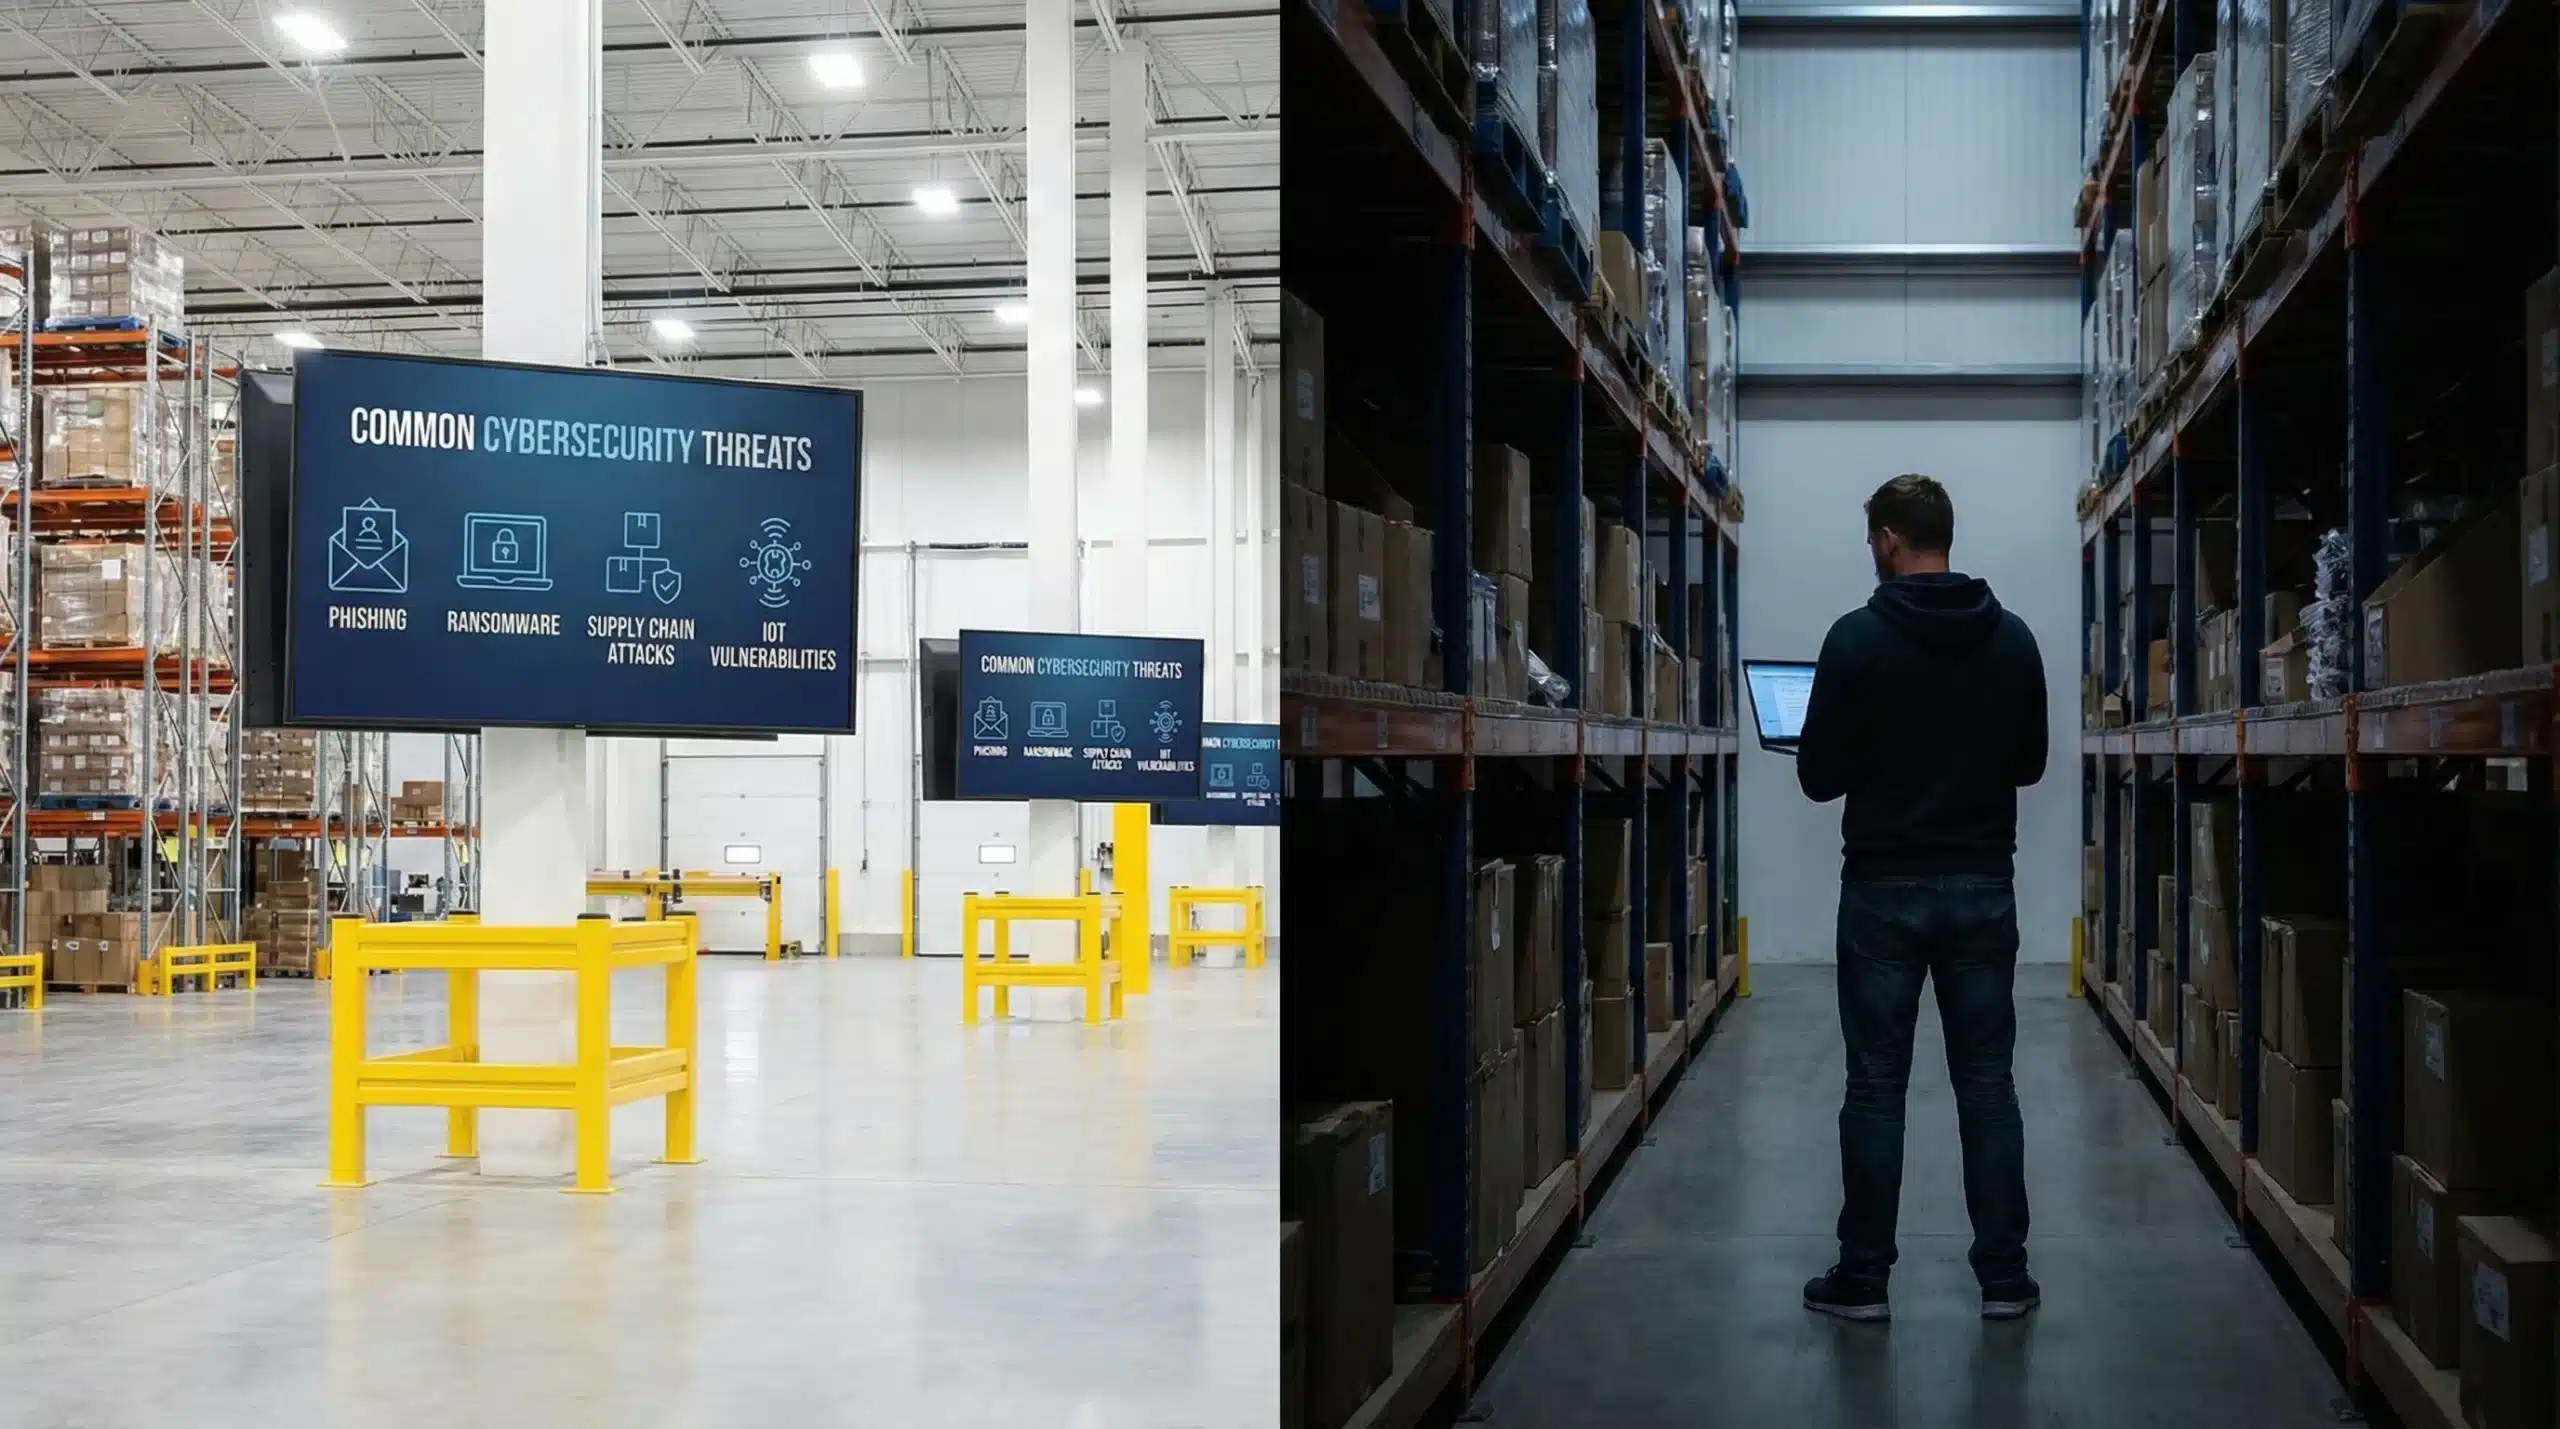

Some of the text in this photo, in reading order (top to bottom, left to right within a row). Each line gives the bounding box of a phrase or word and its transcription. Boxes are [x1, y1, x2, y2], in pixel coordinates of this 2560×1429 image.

[350, 406, 812, 472] COMMON CYBERSECURITY THREATS
[328, 606, 407, 631] PHISHING
[447, 610, 561, 636] RANSOMWARE
[587, 615, 695, 640] SUPPLY CHAIN
[762, 621, 787, 643] IOT
[607, 643, 675, 666] ATTACKS
[710, 645, 837, 671] VULNERABILITIES
[980, 654, 1183, 680] COMMON CYBERSECURITY THREATS
